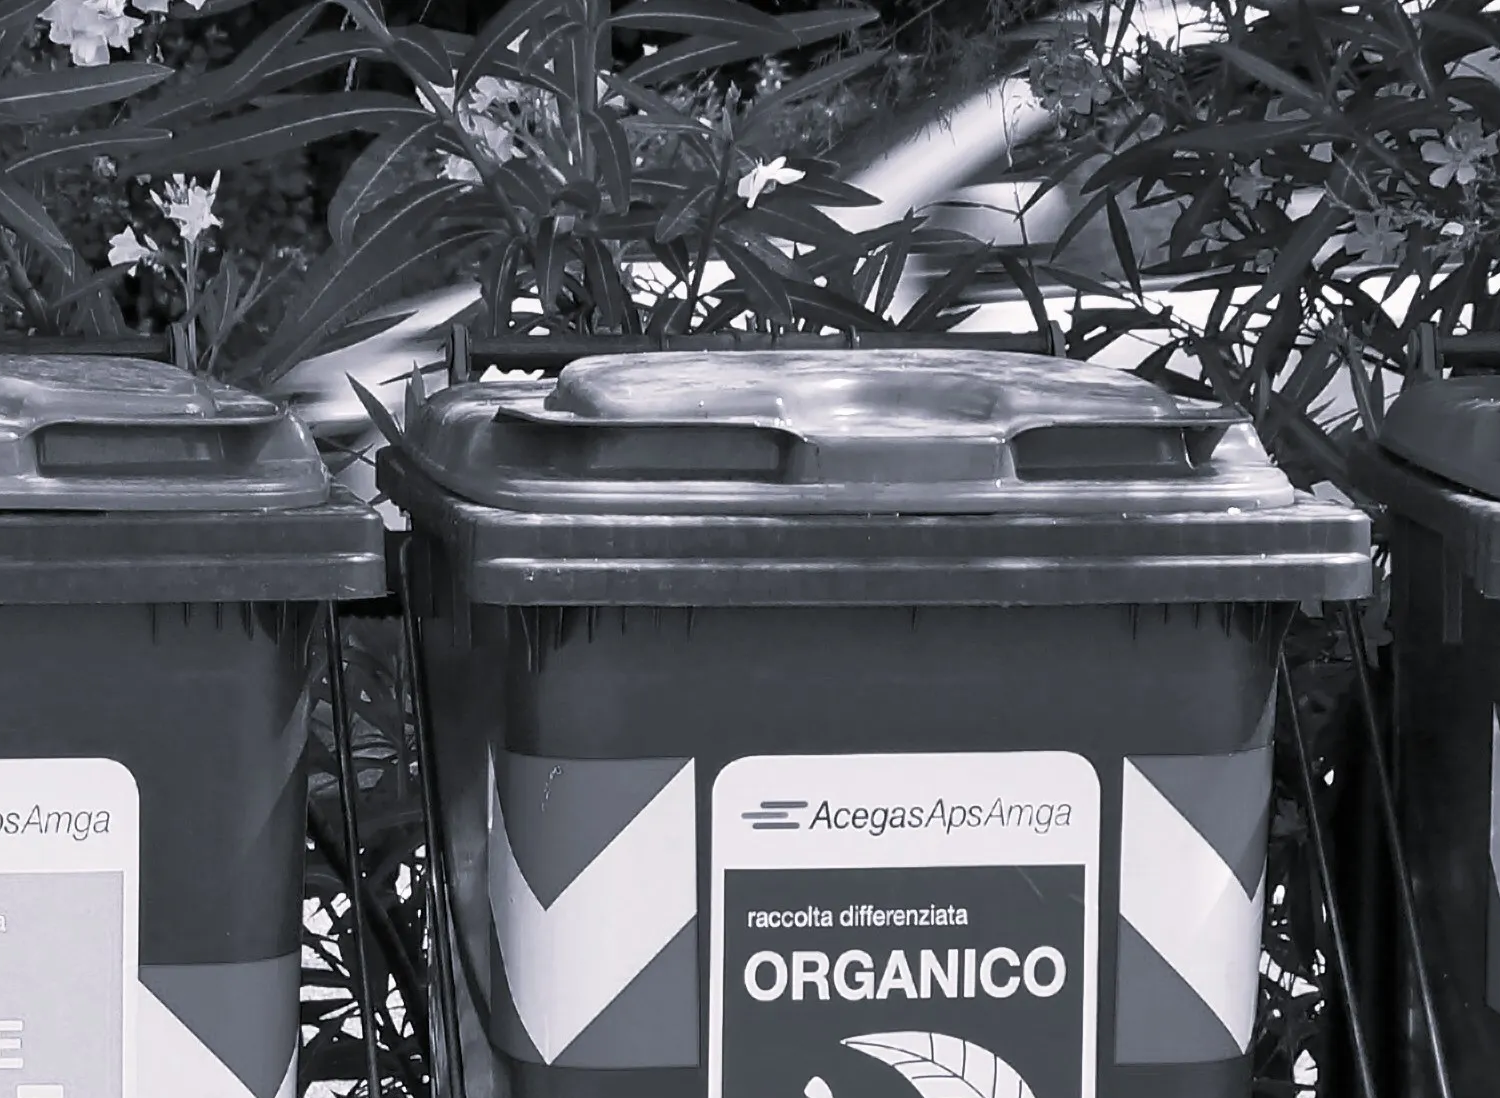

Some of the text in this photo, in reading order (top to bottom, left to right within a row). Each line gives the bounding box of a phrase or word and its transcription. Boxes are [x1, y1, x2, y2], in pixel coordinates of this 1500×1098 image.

[809, 798, 1072, 836] AcegasApsAmga
[748, 905, 968, 927] raccolta differenziata
[743, 945, 1067, 1002] ORGANICO
